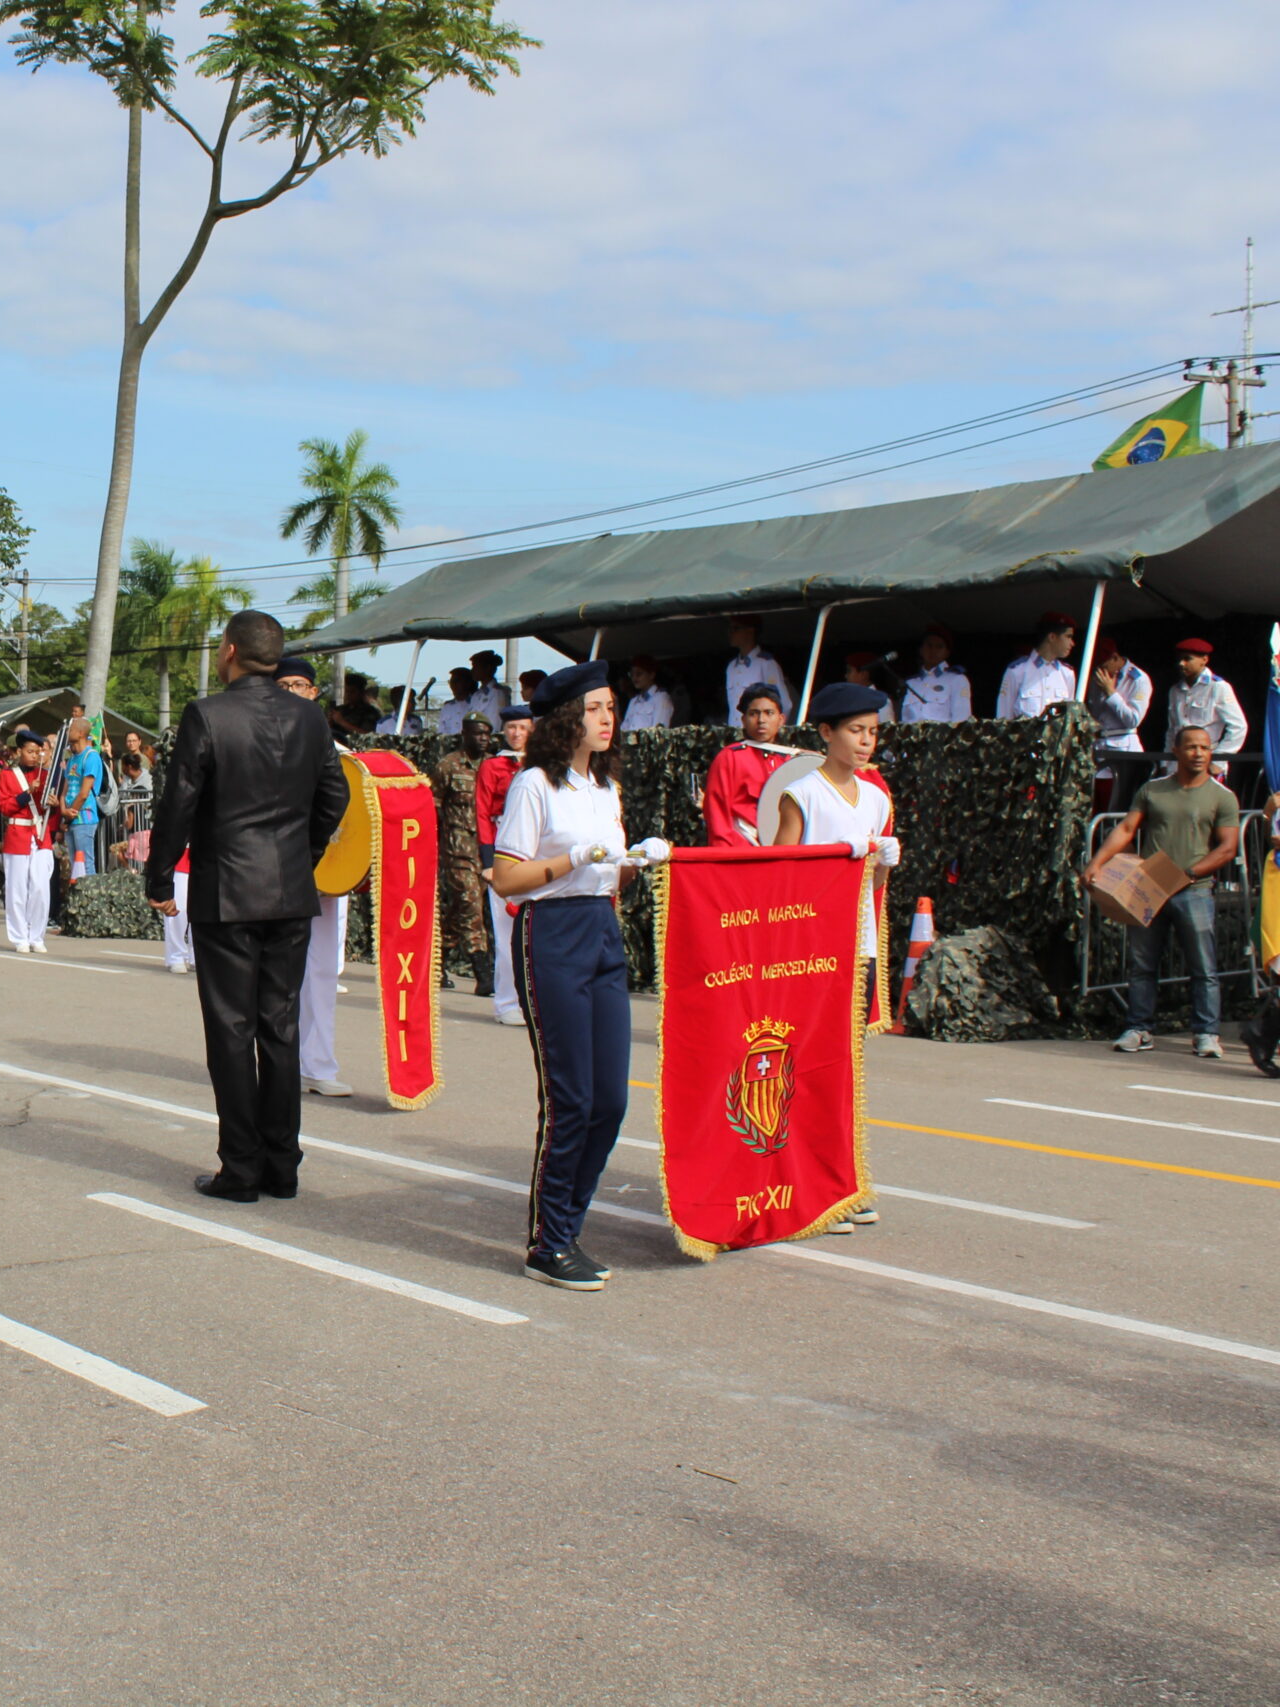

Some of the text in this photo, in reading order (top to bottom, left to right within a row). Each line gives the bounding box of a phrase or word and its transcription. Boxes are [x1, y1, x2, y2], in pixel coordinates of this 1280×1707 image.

[720, 902, 817, 929] BANDA MARCIAL
[396, 818, 421, 1062] PIO XII
[704, 953, 838, 988] COLÉGIO MERCEDÁRIO
[764, 1185, 793, 1210] XII
